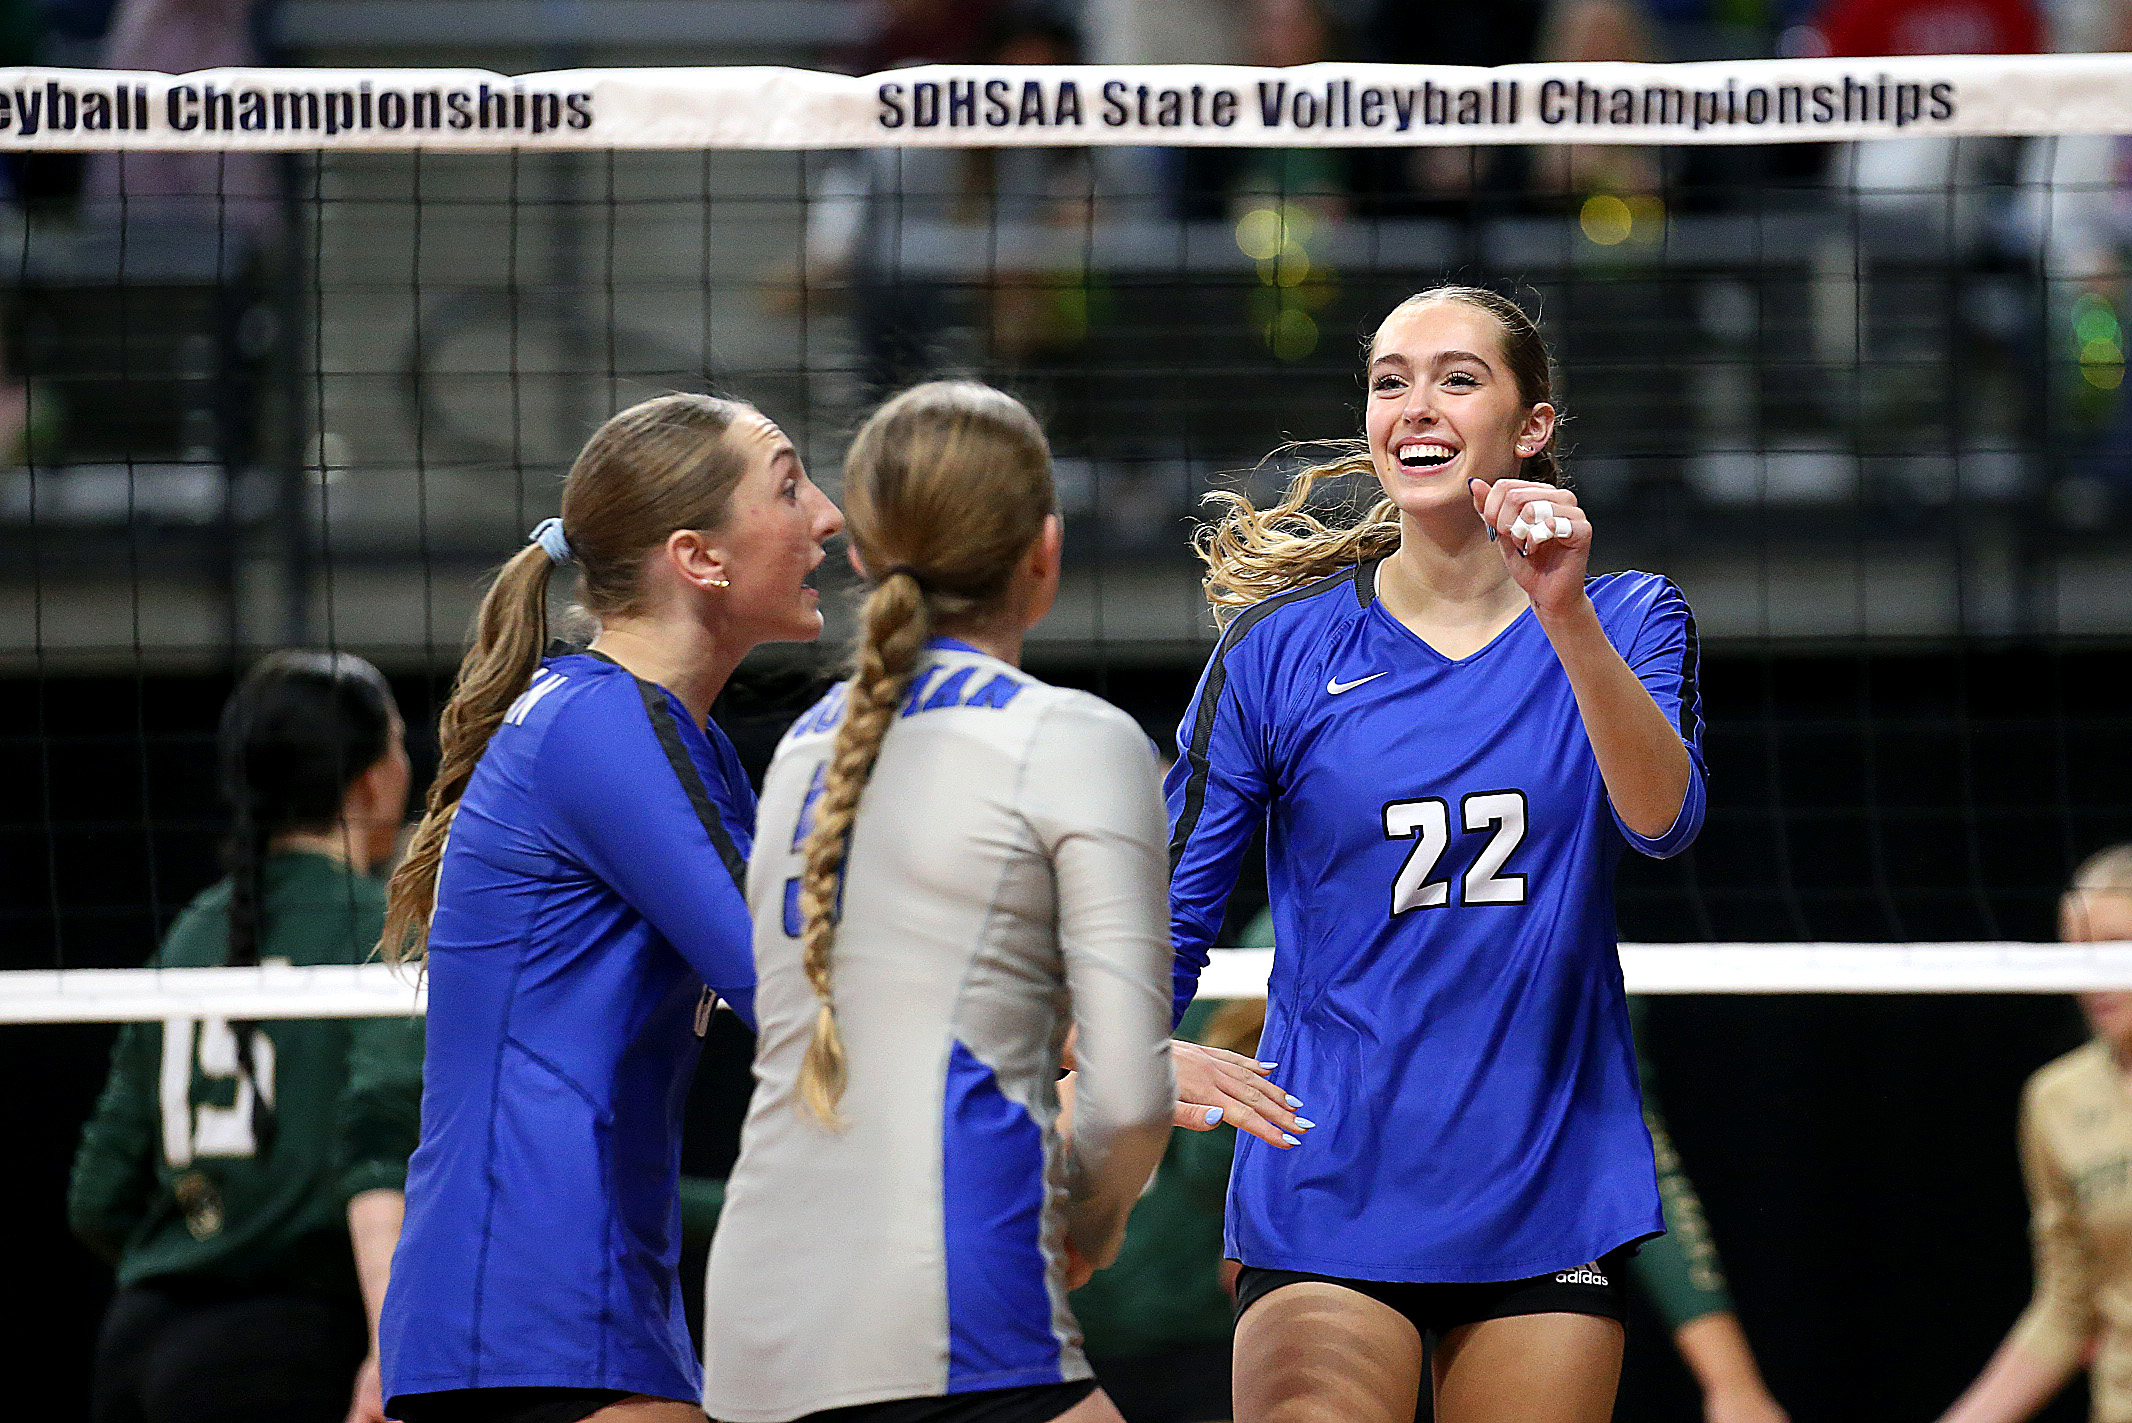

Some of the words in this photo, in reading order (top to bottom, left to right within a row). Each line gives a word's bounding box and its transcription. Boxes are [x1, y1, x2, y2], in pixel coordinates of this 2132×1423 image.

[167, 78, 593, 136] Championships
[878, 80, 1083, 129] SDHSAA
[1103, 81, 1239, 128] State
[1257, 79, 1519, 132] Volleyball
[1539, 75, 1955, 130] Championships
[1382, 788, 1529, 919] 22
[160, 958, 277, 1167] 15
[1555, 1269, 1609, 1286] adidas
